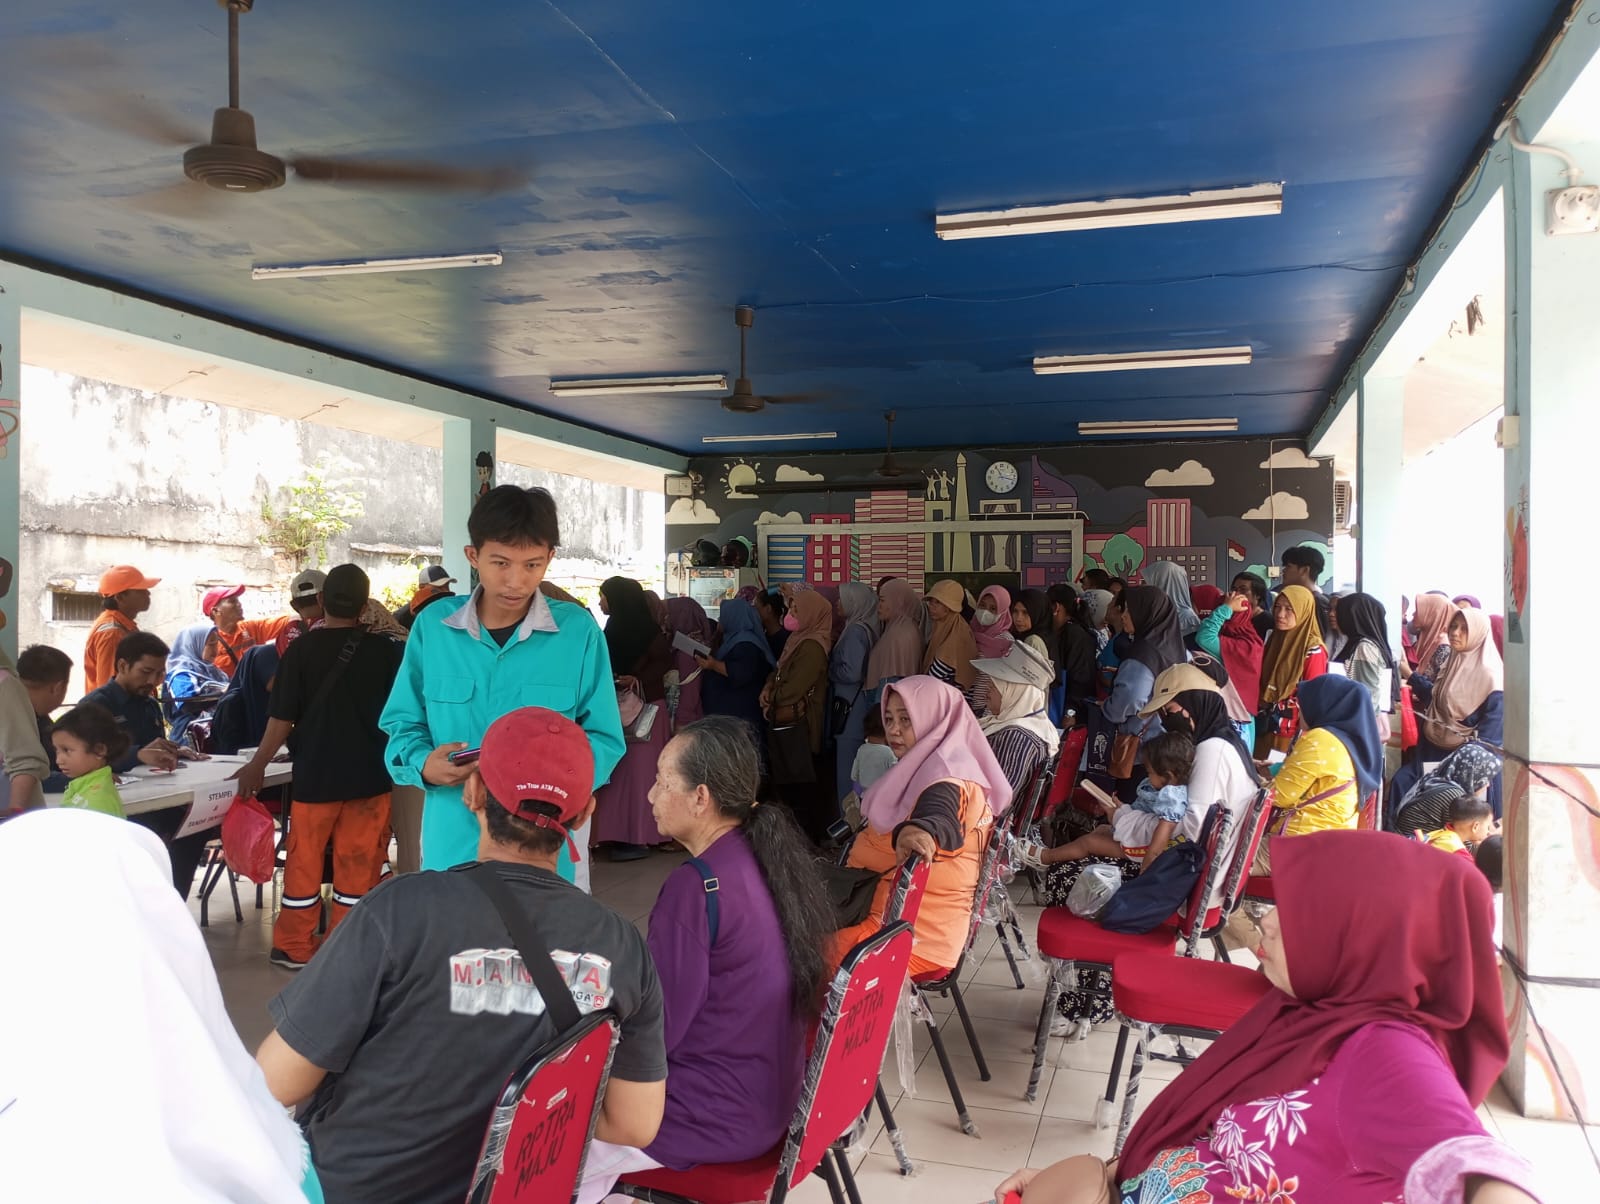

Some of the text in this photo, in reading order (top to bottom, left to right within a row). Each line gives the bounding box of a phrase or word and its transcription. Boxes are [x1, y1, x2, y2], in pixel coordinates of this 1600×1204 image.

[208, 790, 233, 802] STEMPEL
[514, 1094, 576, 1170] RPTRA
[514, 1130, 566, 1198] MAJU
